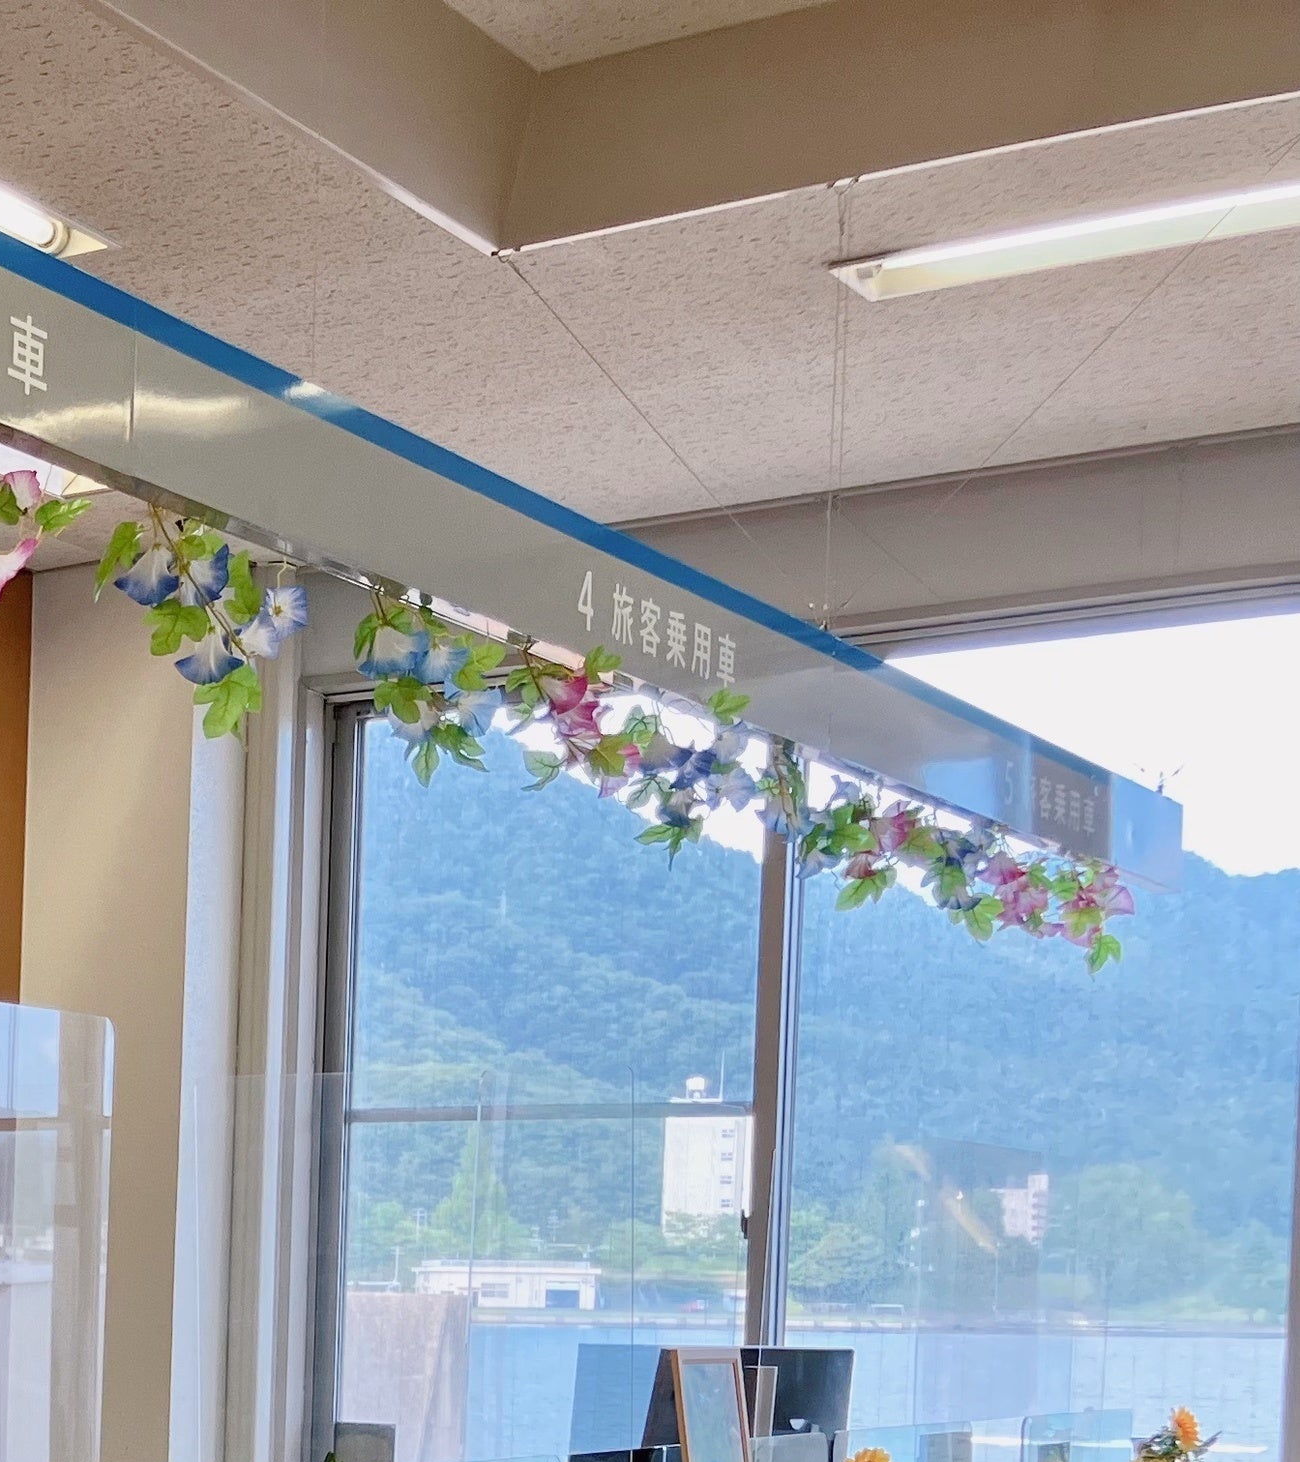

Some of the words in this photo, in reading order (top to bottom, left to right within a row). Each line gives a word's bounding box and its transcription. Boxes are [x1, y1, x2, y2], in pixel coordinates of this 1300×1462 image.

[577, 570, 594, 632] 4
[611, 583, 736, 688] 旅客乗用車
